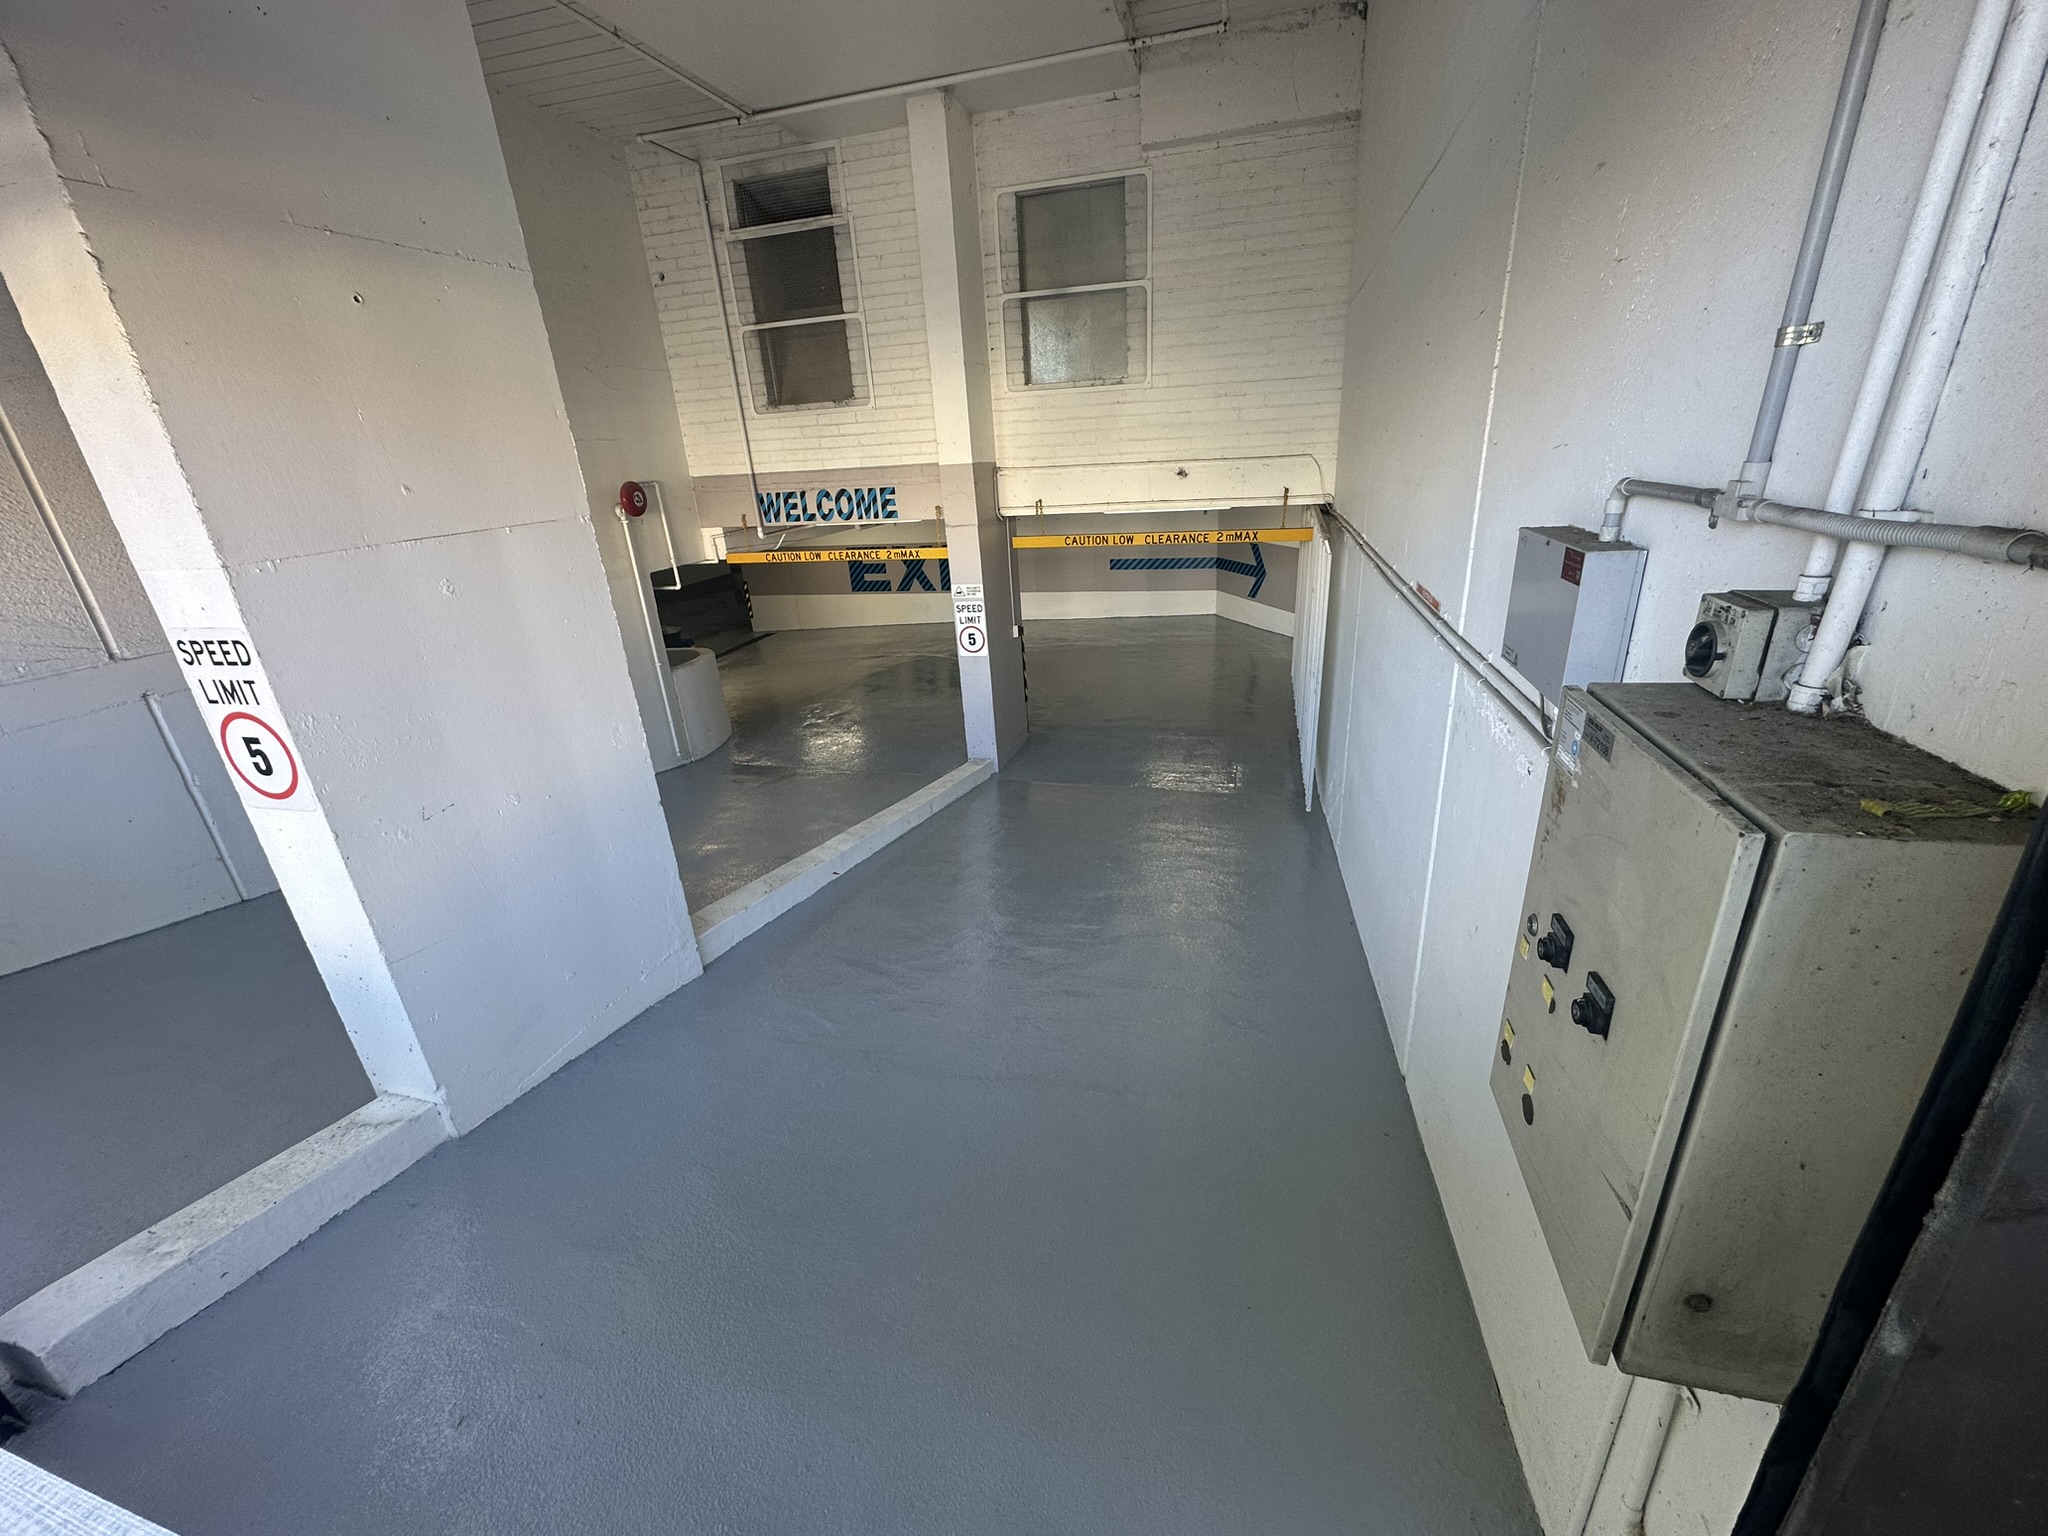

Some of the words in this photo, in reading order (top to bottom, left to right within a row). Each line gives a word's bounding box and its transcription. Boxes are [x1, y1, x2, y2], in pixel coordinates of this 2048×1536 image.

[757, 487, 898, 523] WELCOME
[1064, 535, 1109, 546] CAUTION
[1113, 535, 1134, 545] LOW
[1144, 533, 1210, 545] CLEARANCE
[765, 552, 802, 562] CAUTION
[804, 552, 822, 561] LOW
[828, 550, 881, 561] CLEARANCE
[956, 604, 983, 613] SPEED
[959, 616, 981, 624] LIMIT
[968, 633, 977, 646] 5
[176, 640, 251, 666] SPEED
[198, 679, 260, 705] LIMIT
[242, 736, 274, 776] 5
